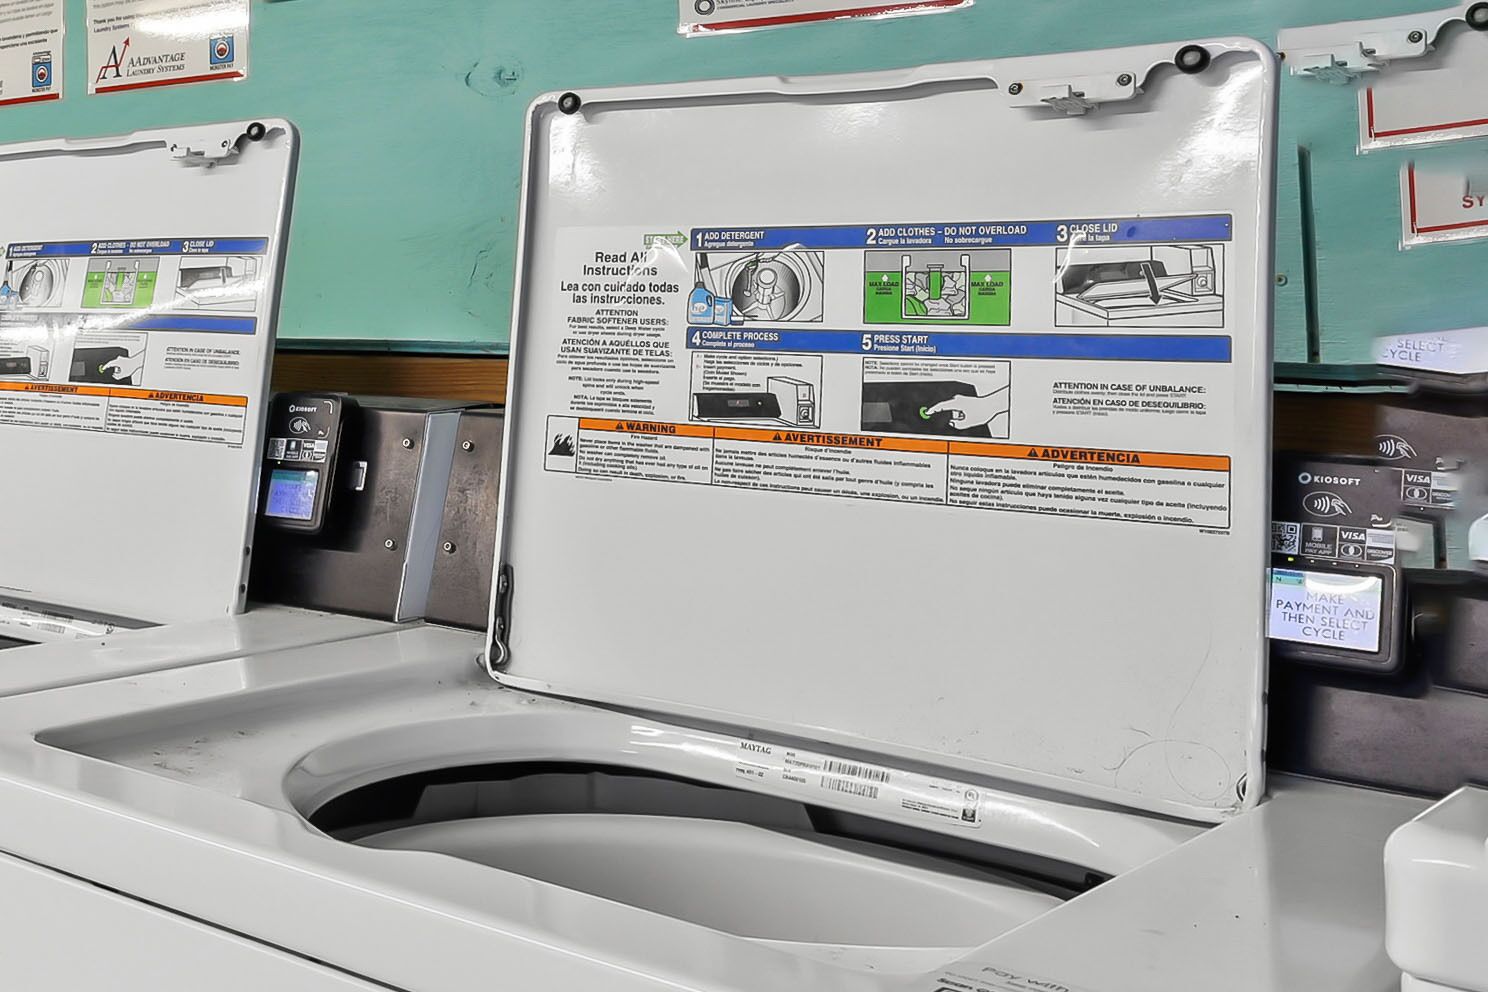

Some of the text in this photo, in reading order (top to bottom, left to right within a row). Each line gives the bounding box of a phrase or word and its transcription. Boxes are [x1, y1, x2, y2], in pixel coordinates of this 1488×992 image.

[866, 228, 876, 244] 2
[898, 227, 935, 236] CLOTHES
[944, 227, 956, 235] DO
[959, 226, 976, 235] NOT
[978, 225, 1026, 235] OVERLOAD
[1057, 225, 1067, 242] 3
[1070, 224, 1100, 233] CLOSE
[1103, 223, 1118, 232] LID
[696, 232, 702, 247] 1
[721, 231, 764, 239] DETERGENT
[182, 241, 189, 252] 3
[595, 252, 627, 263] Read
[561, 281, 579, 292] Lea
[583, 283, 601, 292] con
[649, 282, 679, 293] todas
[573, 293, 665, 305] las instrucciones.
[692, 331, 778, 346] 4 COMPLETE PROCESS
[862, 334, 928, 350] 5 PRESS START
[1053, 382, 1098, 390] ATTENTION
[1149, 385, 1206, 394] UNBALANCE:
[155, 392, 204, 402] ADVERTENCIA
[1053, 397, 1091, 405] ATENCIÓN
[1142, 401, 1206, 409] DESEQUILIBRIO:
[626, 422, 676, 433] WARNING
[784, 433, 883, 447] AVERTISSEMENT
[1042, 450, 1140, 464] ADVERTENCIA
[1314, 475, 1361, 486] KIOSOFT
[1406, 474, 1430, 483] VISA
[1341, 531, 1365, 540] VISA
[1306, 592, 1344, 604] MAKE
[1276, 600, 1375, 620] PAYMENT AND
[1282, 612, 1368, 630] THEN SELECT
[1302, 626, 1344, 640] CYCLE
[740, 742, 771, 754] MAYTAG
[982, 967, 1022, 980] Pay
[1027, 979, 1069, 992] with
